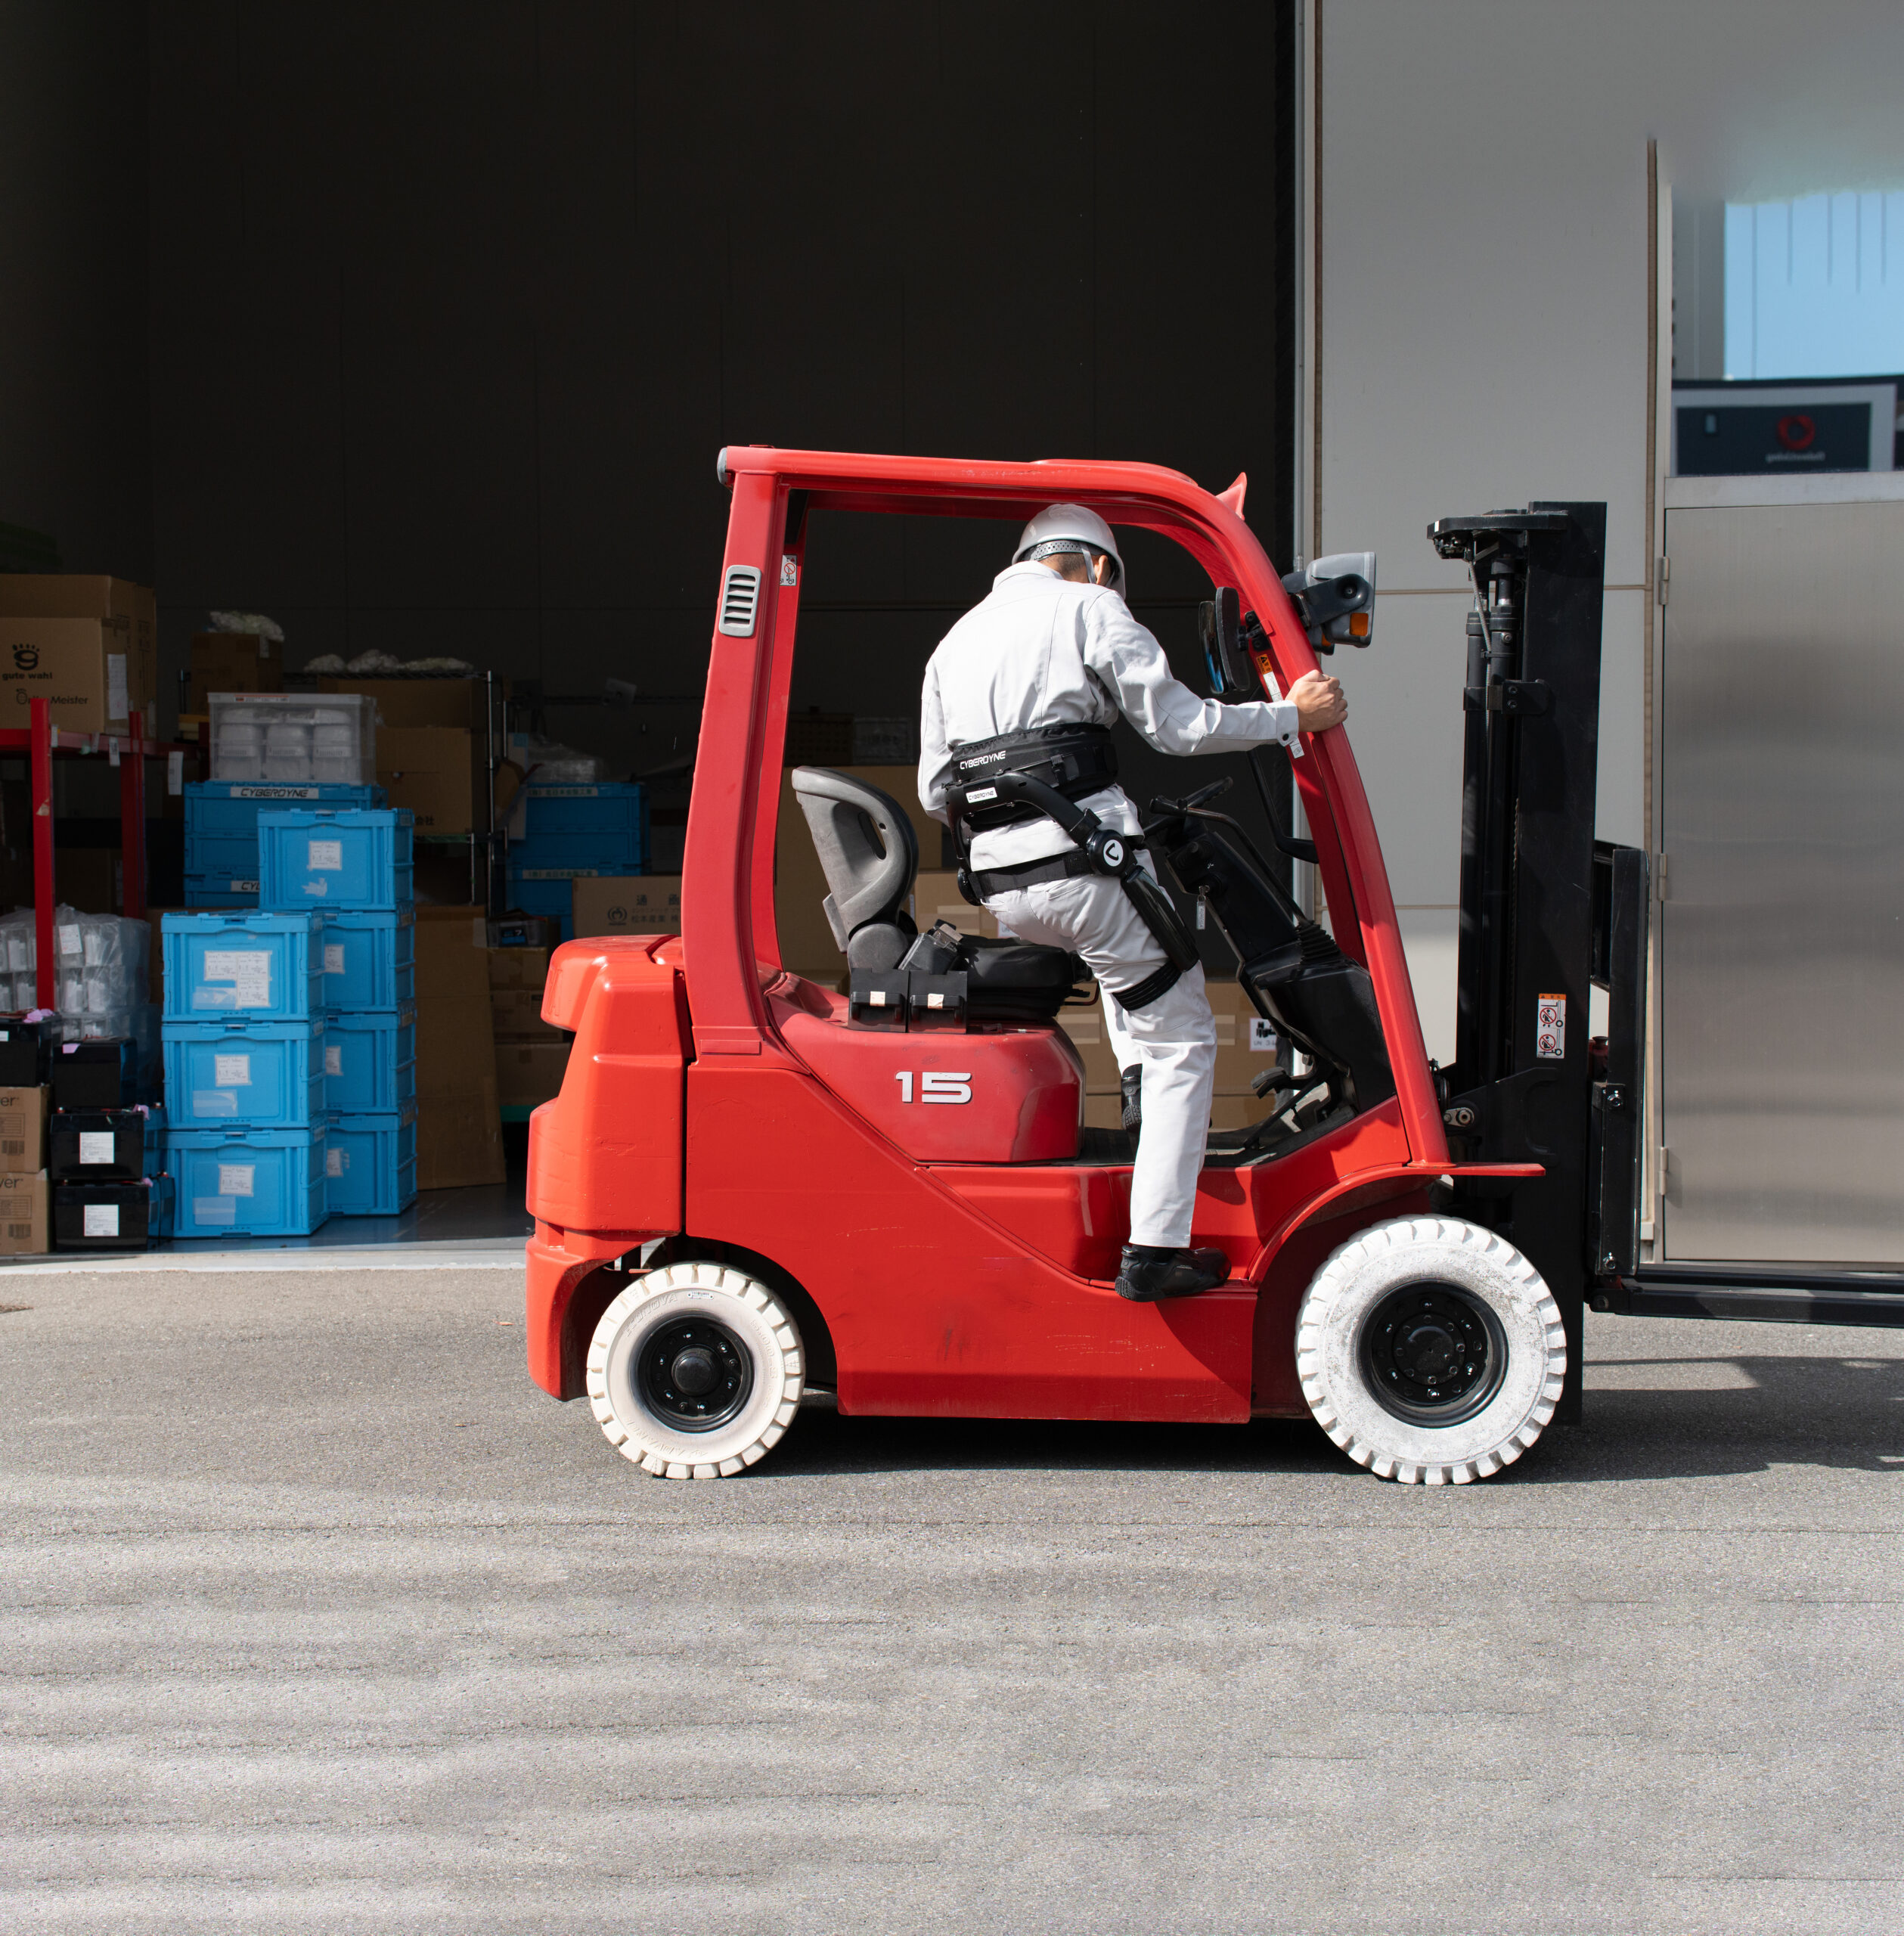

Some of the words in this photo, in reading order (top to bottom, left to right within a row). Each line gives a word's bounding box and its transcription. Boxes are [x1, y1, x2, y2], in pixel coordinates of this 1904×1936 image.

[2, 672, 25, 681] gute
[50, 696, 88, 704] Meister
[960, 750, 1006, 770] CYBERDYNE
[240, 788, 309, 798] CYBERDYNE
[968, 790, 994, 800] CYBERDYNE
[895, 1071, 972, 1104] 15
